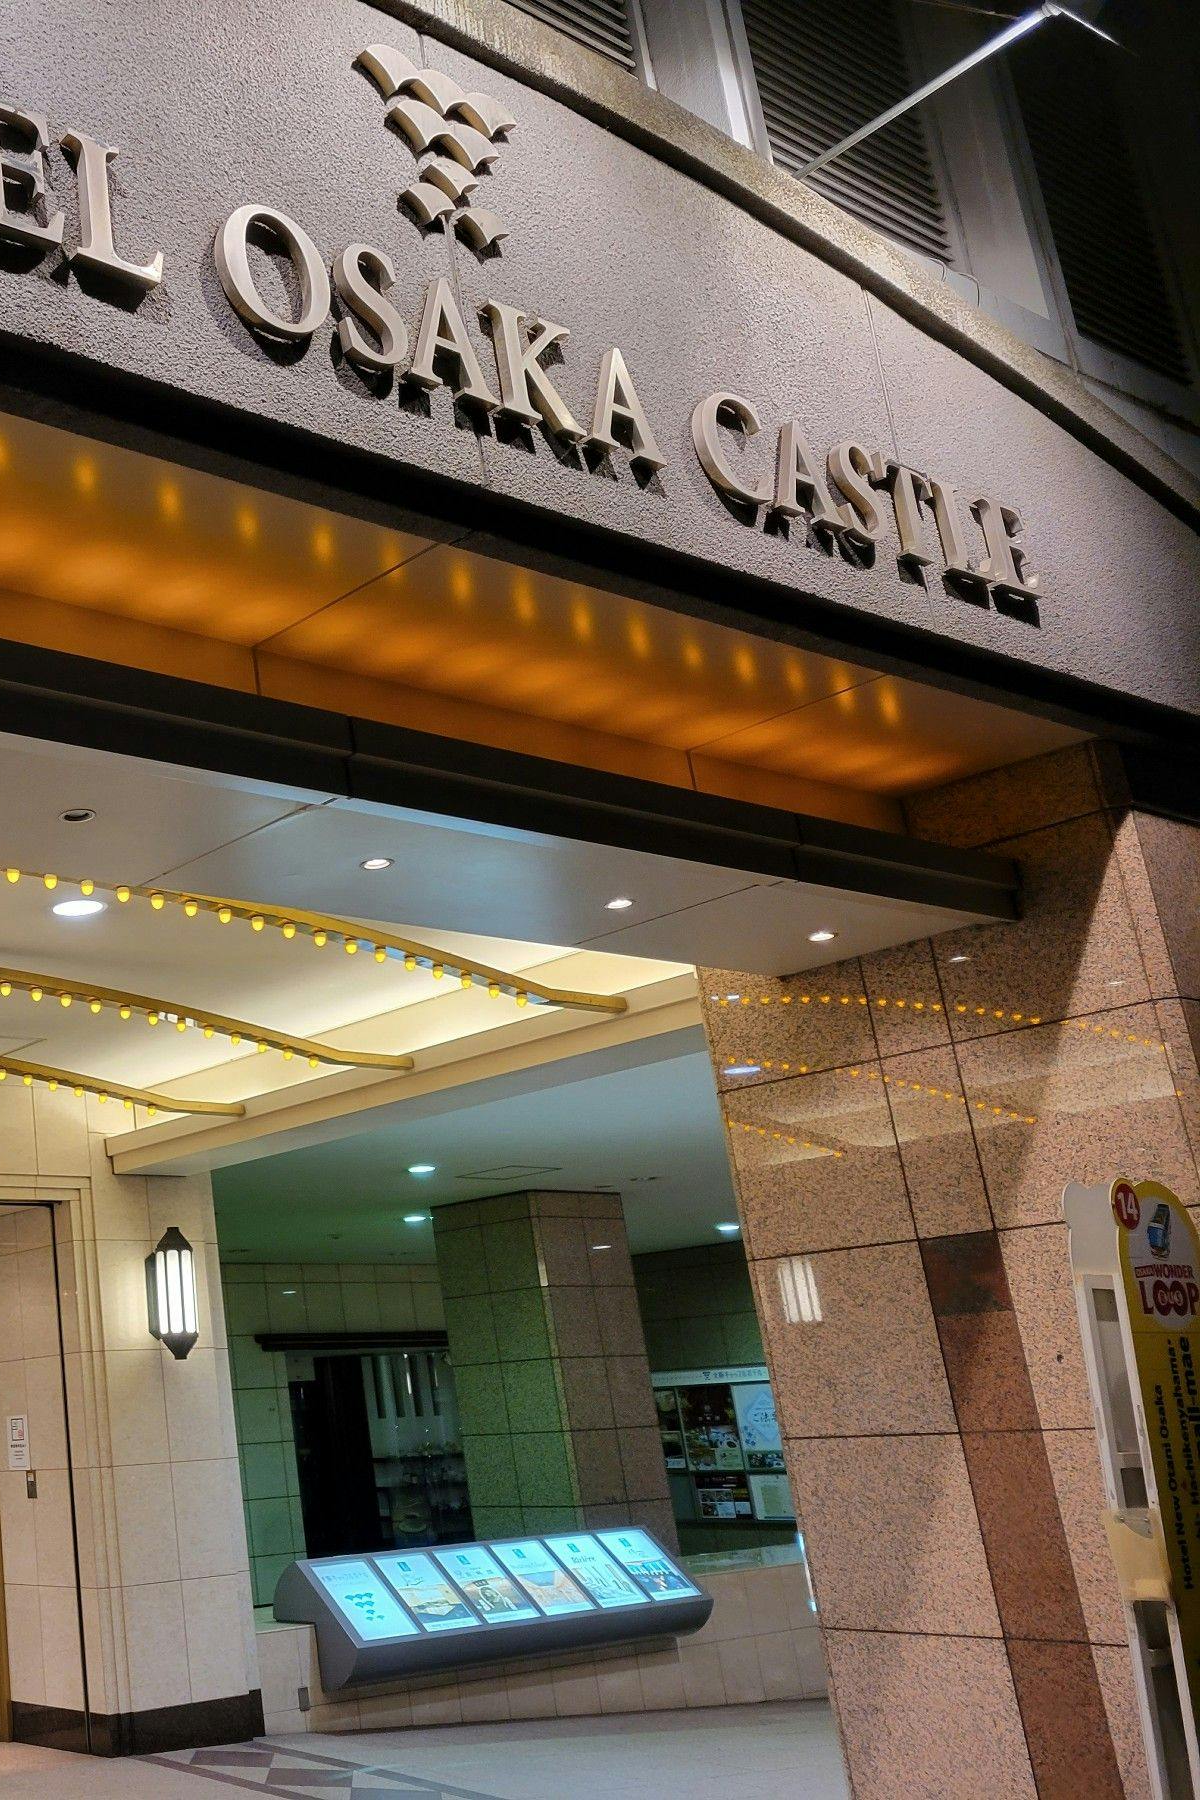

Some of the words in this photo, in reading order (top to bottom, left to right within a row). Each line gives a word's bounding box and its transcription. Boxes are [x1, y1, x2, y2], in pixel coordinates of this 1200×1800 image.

[213, 203, 667, 471] OSAKA
[691, 391, 1043, 600] CASTLE
[1116, 1192, 1139, 1221] 14
[1153, 1264, 1194, 1279] WONDER
[1139, 1280, 1199, 1316] LOOP
[1154, 1383, 1169, 1439] Osaka
[1163, 1443, 1177, 1492] Otani
[1173, 1495, 1186, 1536] New
[1178, 1539, 1195, 1590] Hotel
